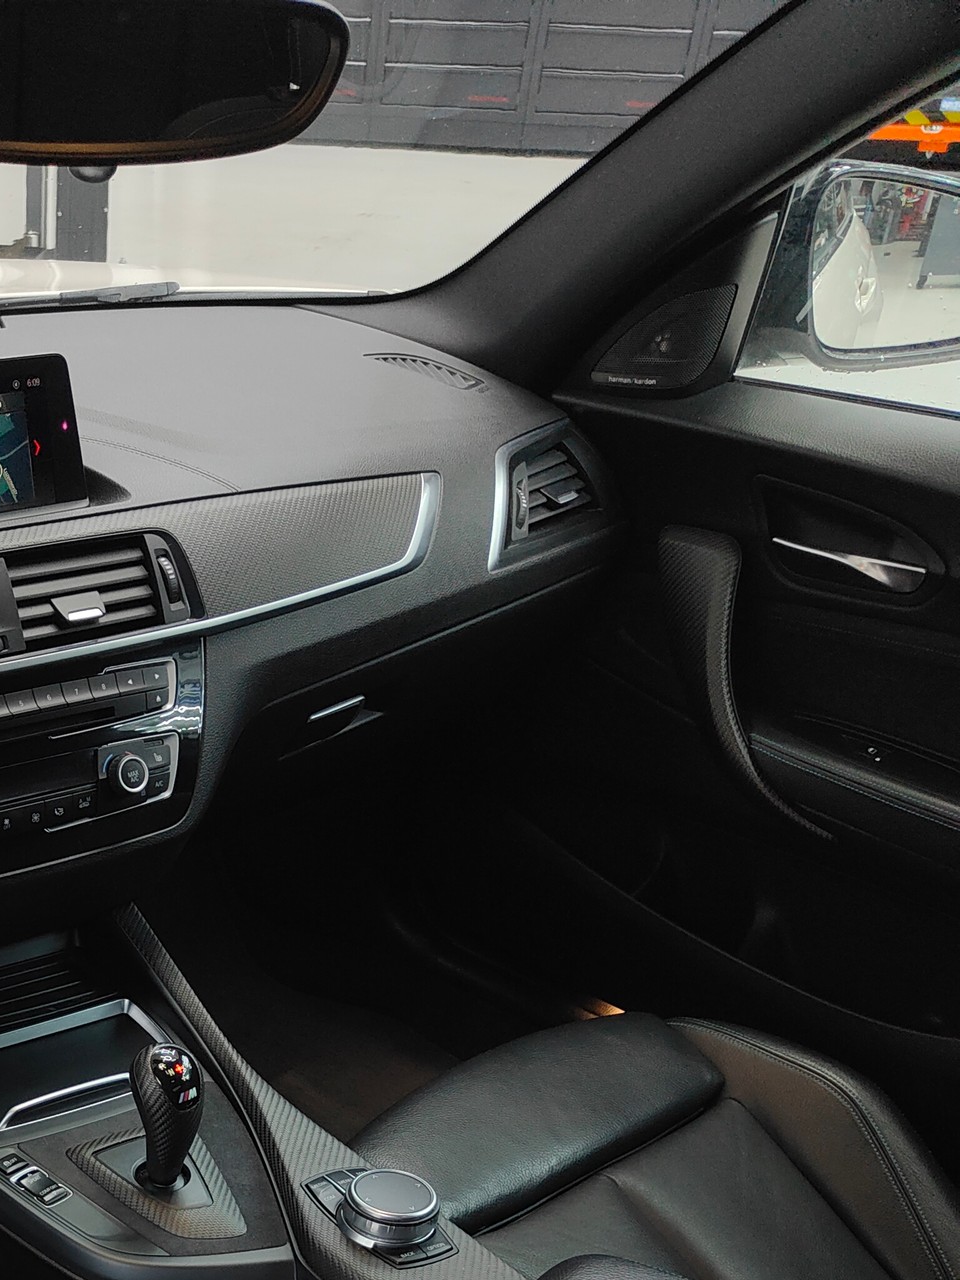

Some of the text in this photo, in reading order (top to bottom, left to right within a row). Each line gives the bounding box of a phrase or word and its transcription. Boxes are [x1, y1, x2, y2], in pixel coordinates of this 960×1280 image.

[26, 377, 41, 388] 6:09
[608, 376, 657, 385] harman/kardon
[127, 769, 139, 778] MAX
[155, 780, 164, 788] A/C
[426, 1242, 446, 1251] OPTION
